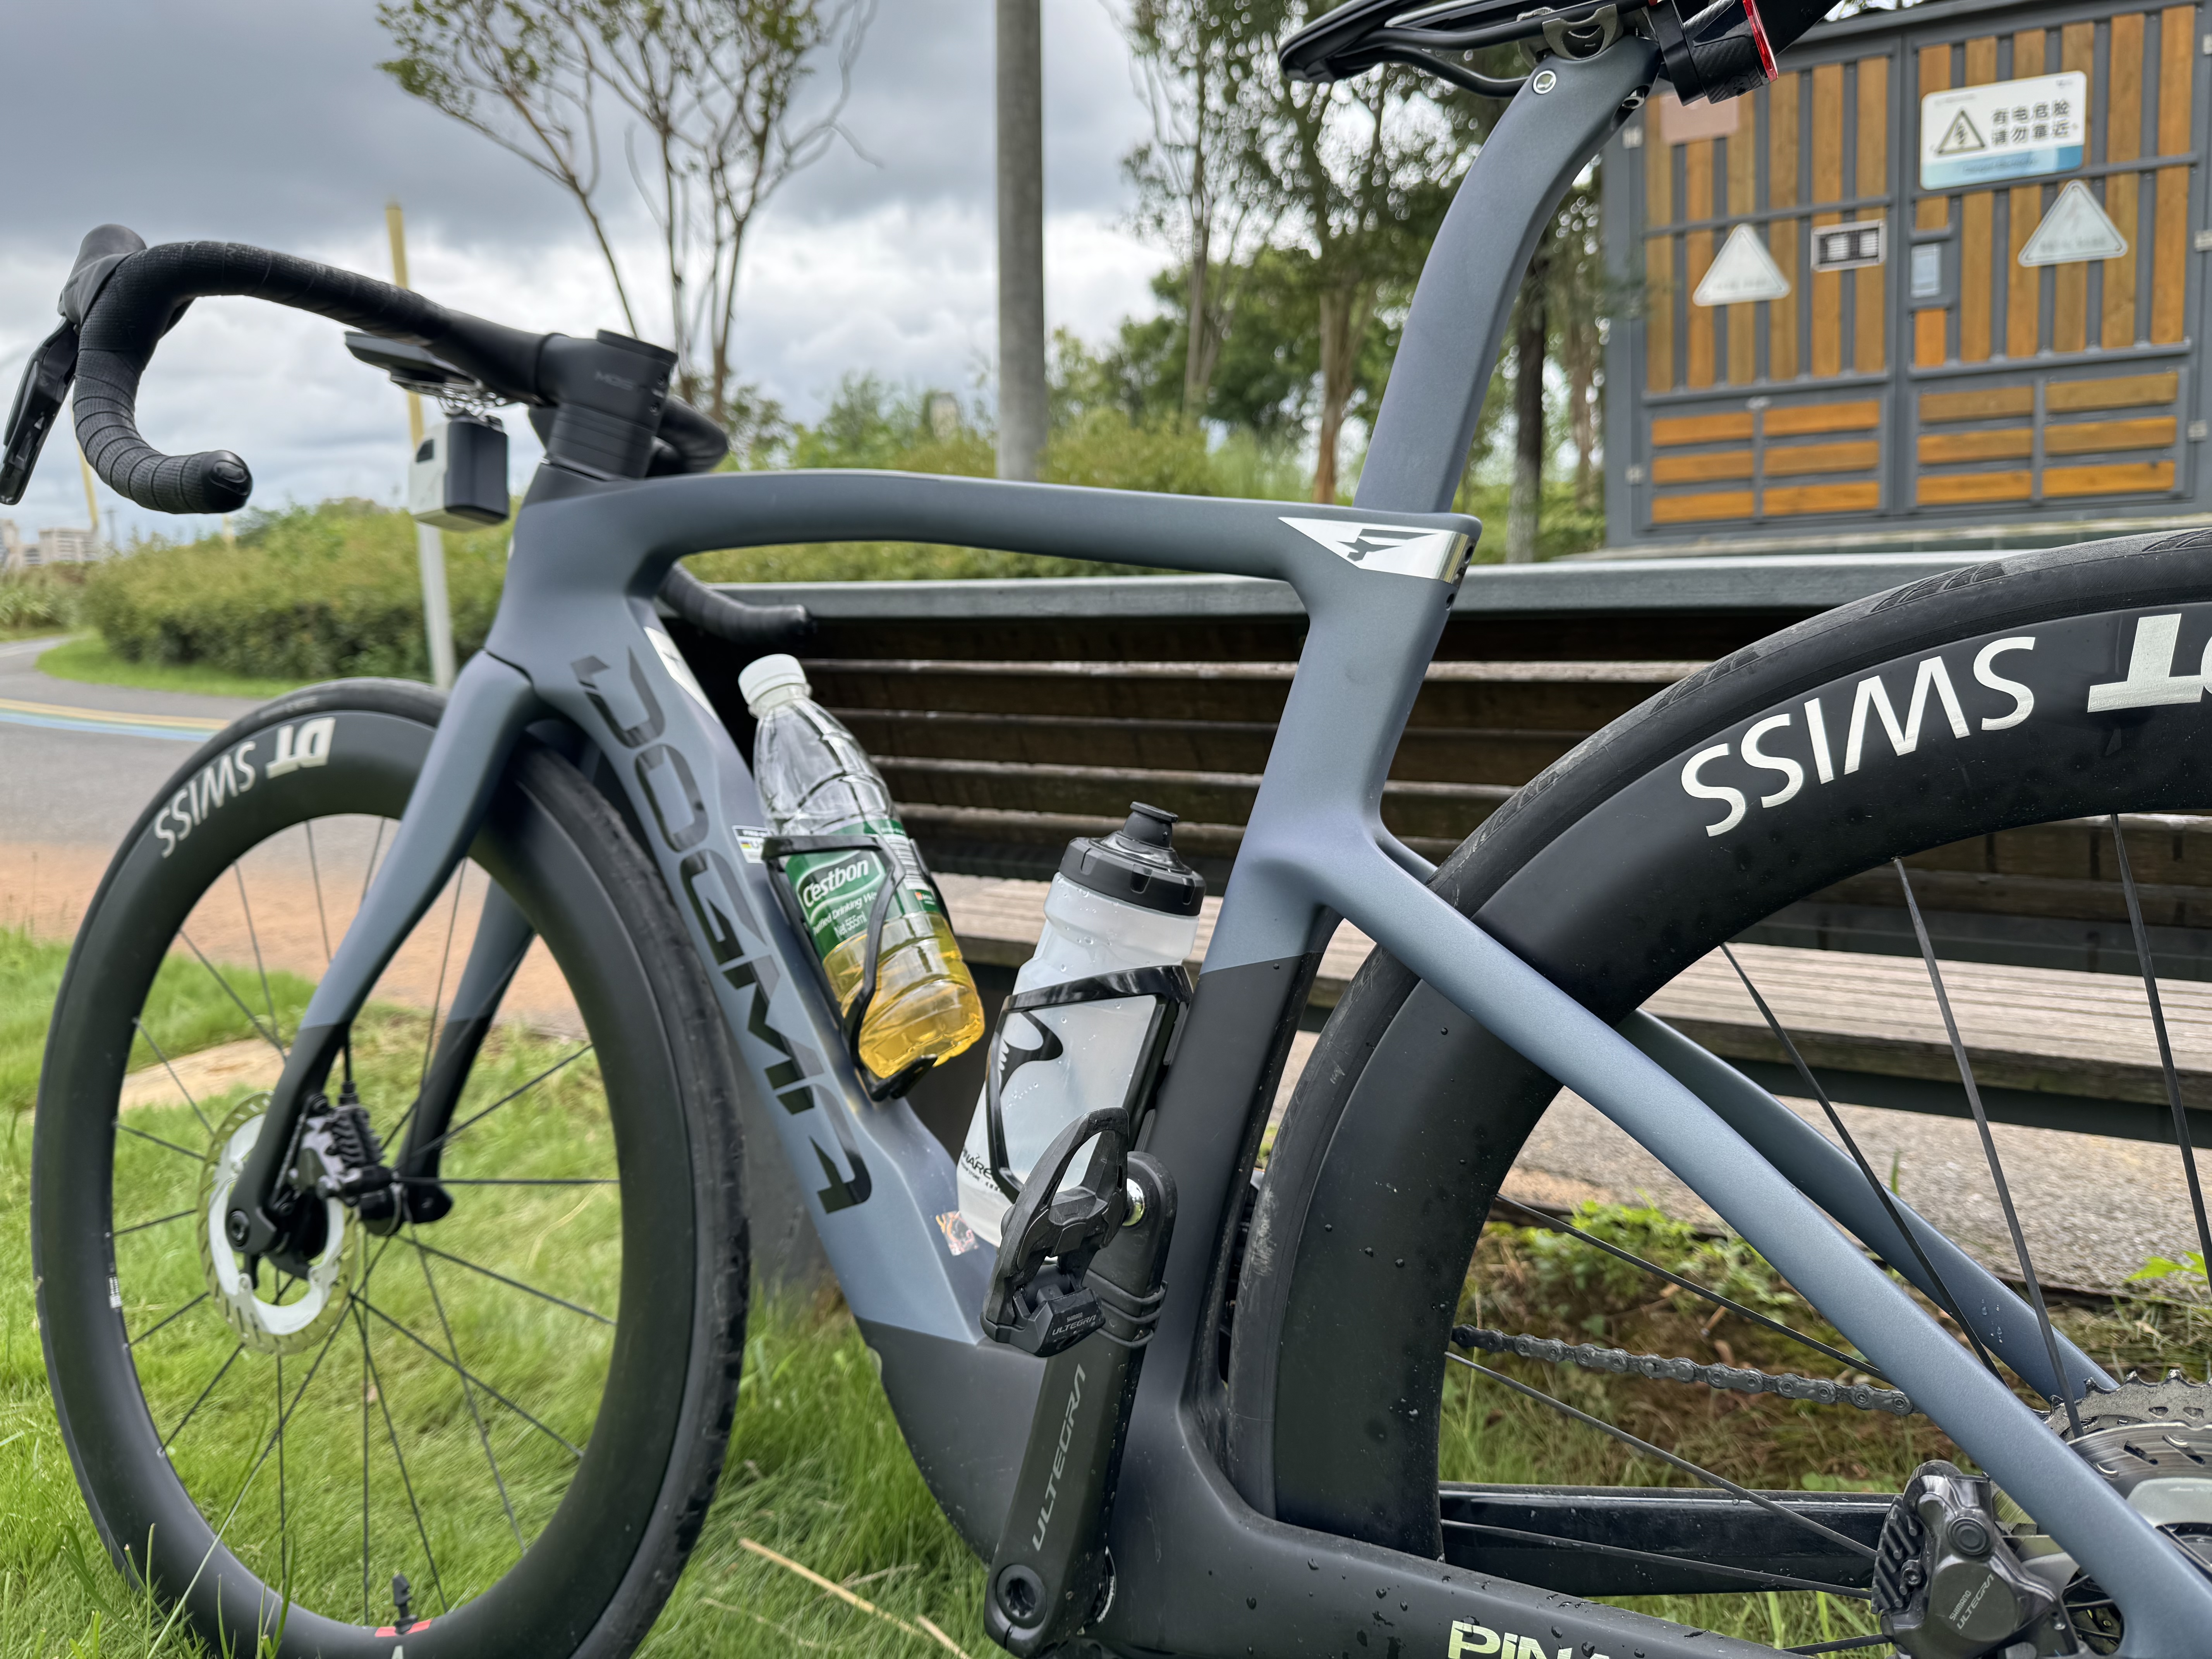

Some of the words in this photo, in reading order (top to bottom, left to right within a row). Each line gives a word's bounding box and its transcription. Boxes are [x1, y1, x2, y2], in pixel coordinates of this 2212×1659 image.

[1993, 98, 2069, 124] 有电危险
[1993, 119, 2069, 143] 请勿靠近
[2087, 613, 2212, 713] T
[265, 717, 336, 778] DT
[1681, 637, 2035, 836] SWISS
[155, 741, 256, 858] SWISS
[571, 645, 872, 1214] DOGMA
[832, 897, 862, 920] Drinking
[1052, 1314, 1096, 1336] ULTEGRA
[1032, 1364, 1085, 1551] ULTEGRA
[1949, 1590, 1972, 1621] SHIMANO
[1957, 1573, 1994, 1630] ULTEGRA
